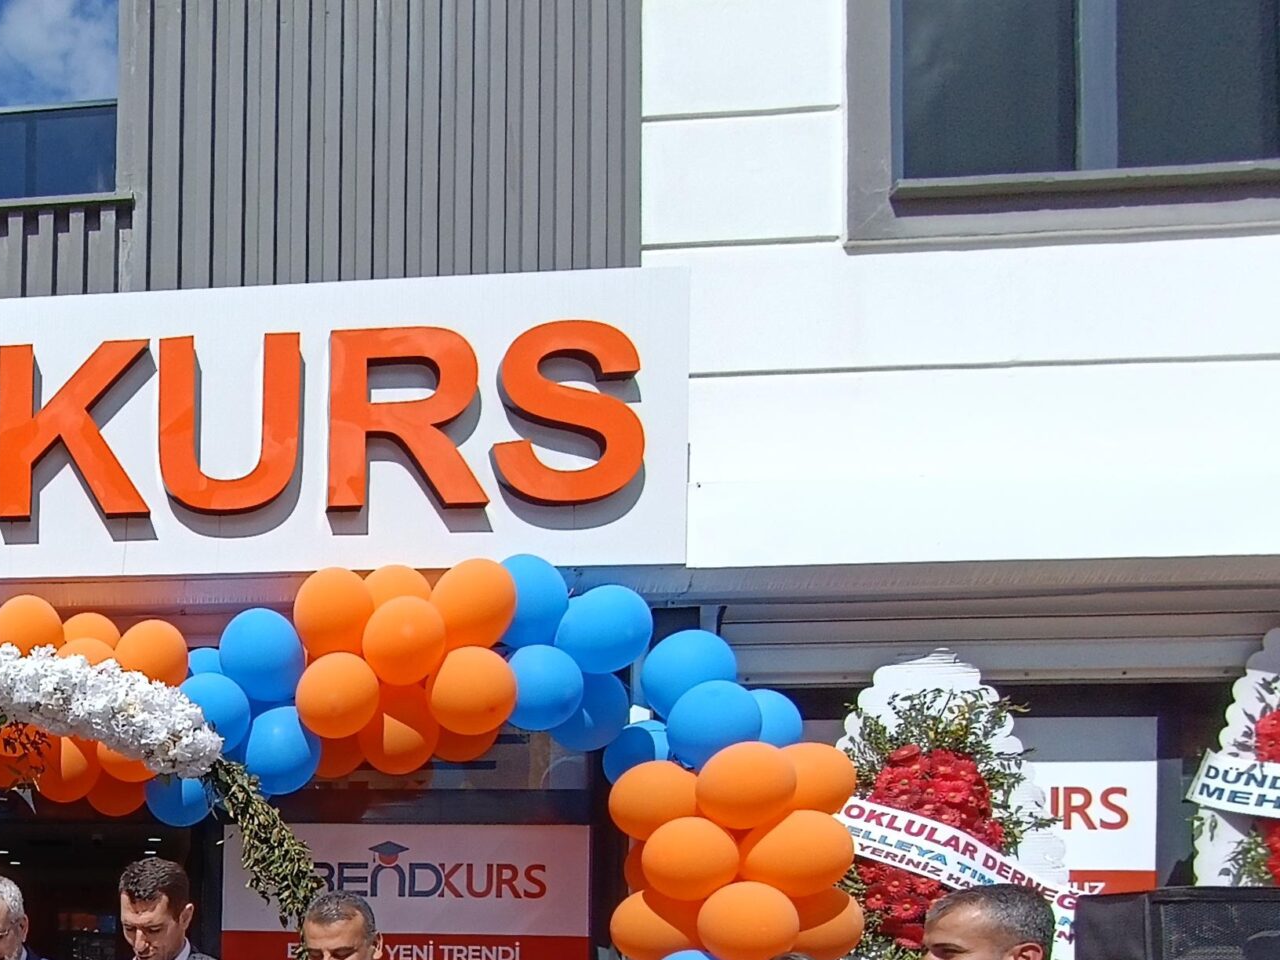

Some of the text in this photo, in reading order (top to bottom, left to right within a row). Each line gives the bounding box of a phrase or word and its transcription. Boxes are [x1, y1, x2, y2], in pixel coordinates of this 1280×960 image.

[1050, 786, 1129, 831] RS
[312, 862, 548, 899] RENDKURS
[982, 853, 1077, 910] DERNEĞ
